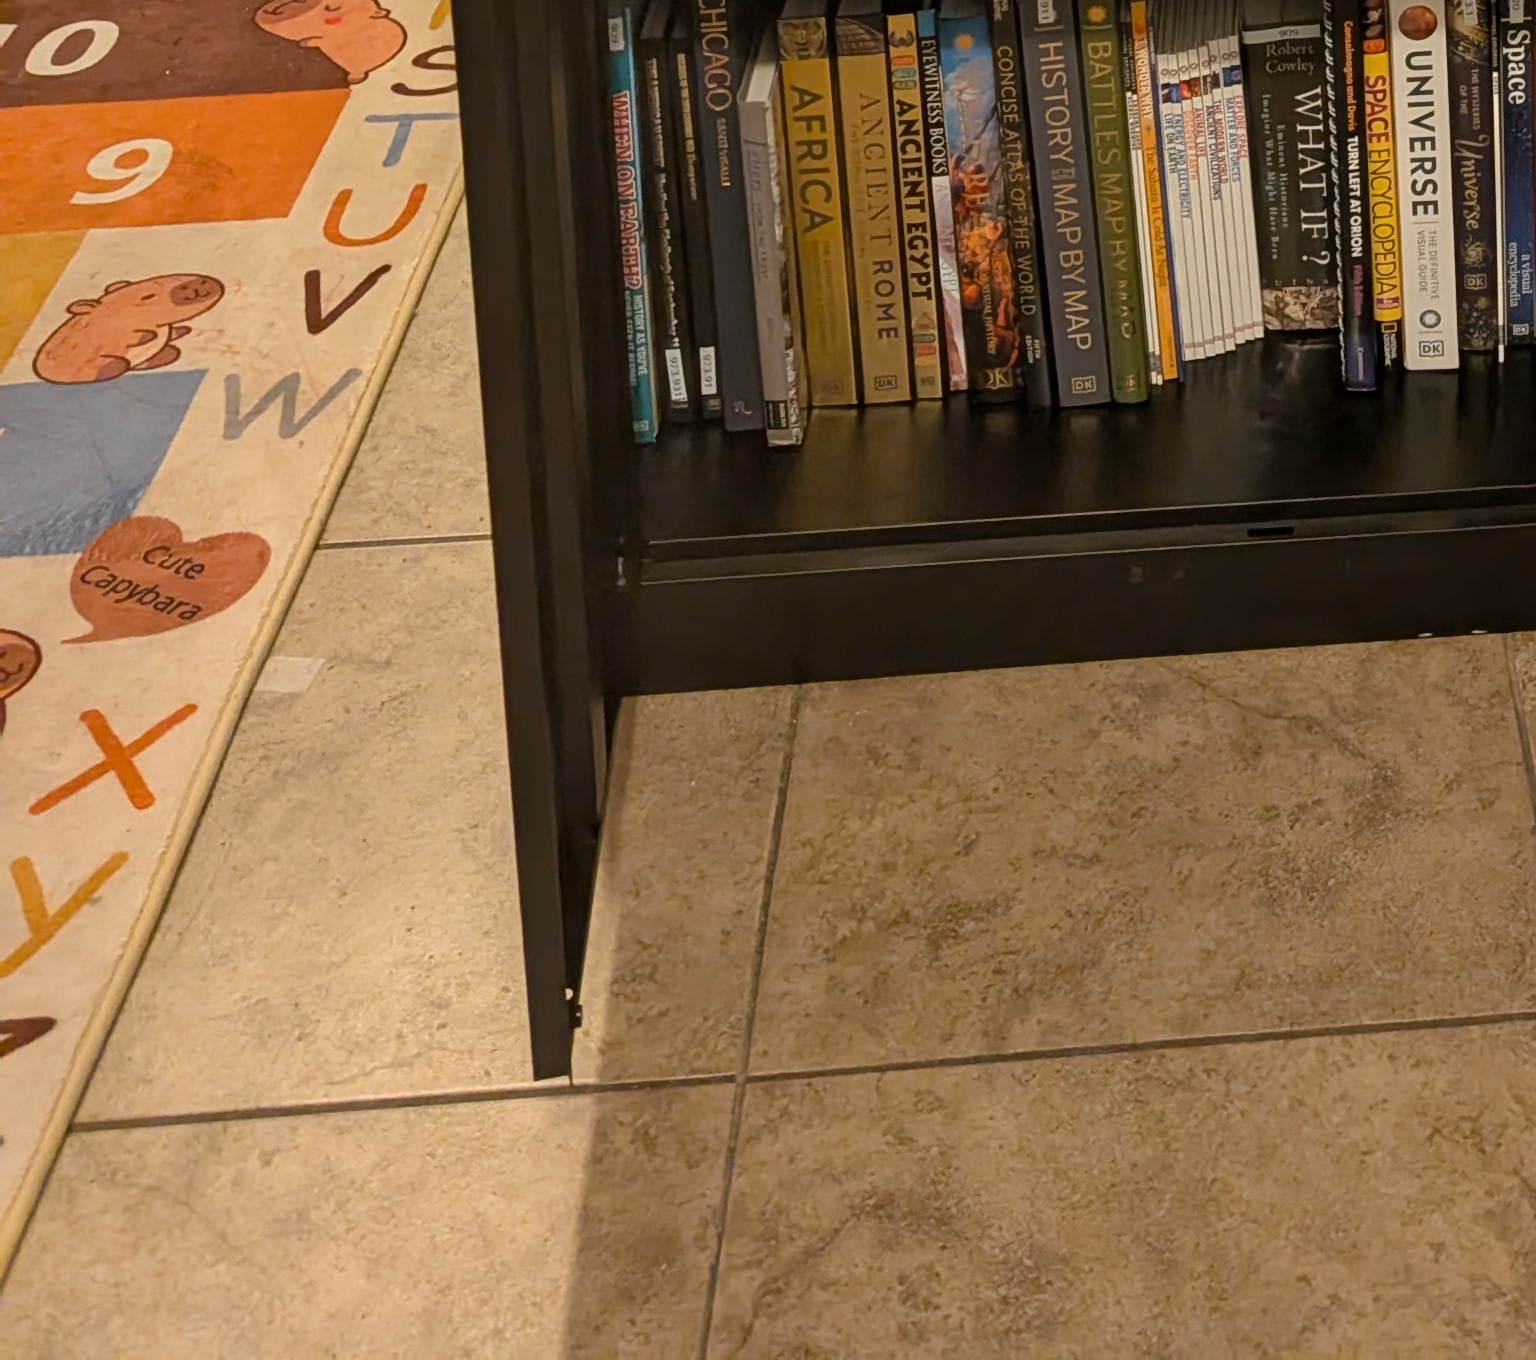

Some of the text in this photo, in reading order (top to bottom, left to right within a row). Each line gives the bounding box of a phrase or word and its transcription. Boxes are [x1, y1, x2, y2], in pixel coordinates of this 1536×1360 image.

[1502, 28, 1532, 106] Space
[364, 112, 459, 167] T
[790, 85, 836, 234] AFRICA
[1404, 50, 1439, 217] UNIVERSE
[69, 138, 174, 206] 9
[1364, 74, 1398, 298] SPACE ENCYCLOPEDIA
[322, 183, 428, 247] U
[858, 94, 899, 340] ANCIENT ROME
[304, 264, 392, 334] V
[222, 367, 363, 440] W
[80, 565, 202, 622] Capybara
[142, 544, 206, 581] Cute
[29, 703, 197, 814] X
